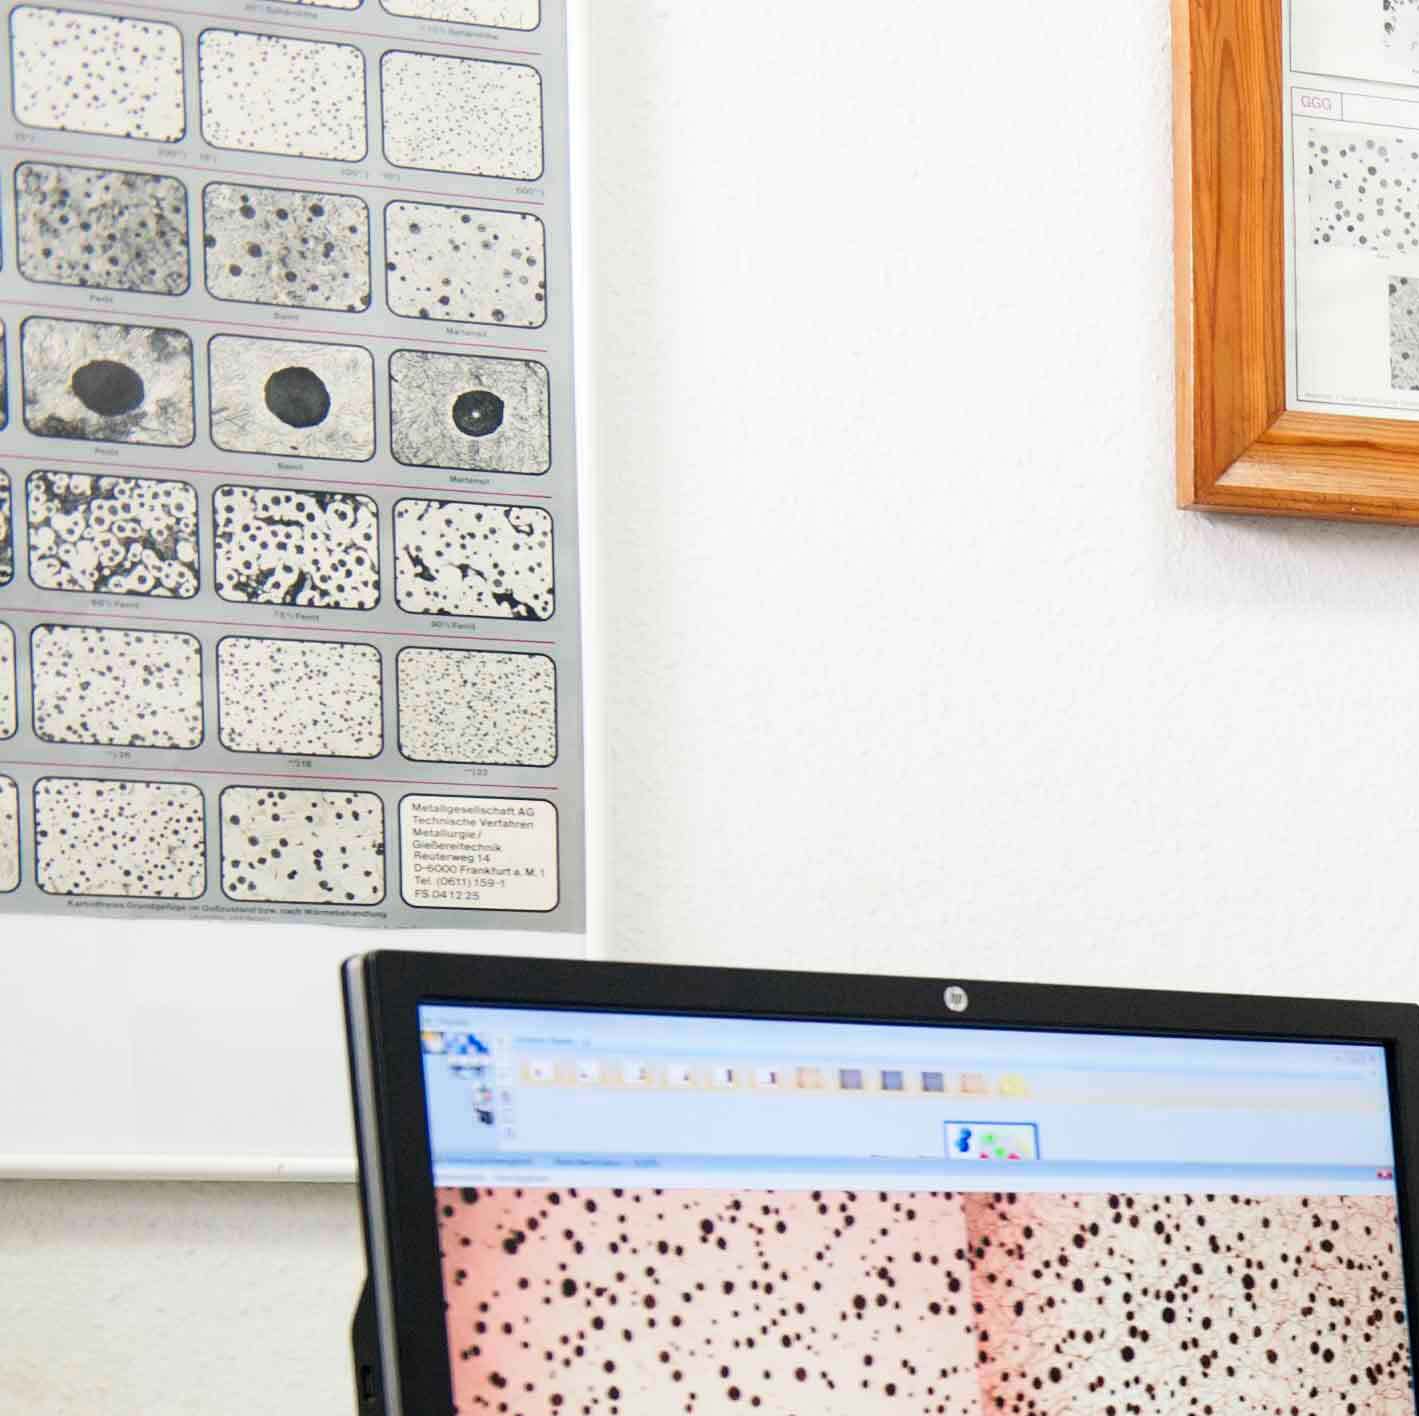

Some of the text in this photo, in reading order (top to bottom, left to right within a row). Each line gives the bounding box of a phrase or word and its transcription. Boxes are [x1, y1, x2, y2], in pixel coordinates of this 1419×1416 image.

[1300, 95, 1332, 111] GGG
[412, 803, 535, 817] Metallgesellschaft AG
[413, 815, 534, 829] Technische Verfahren
[414, 851, 490, 863] Reuterweg 14
[459, 865, 511, 875] Frankfurt
[415, 876, 432, 885] Tel.
